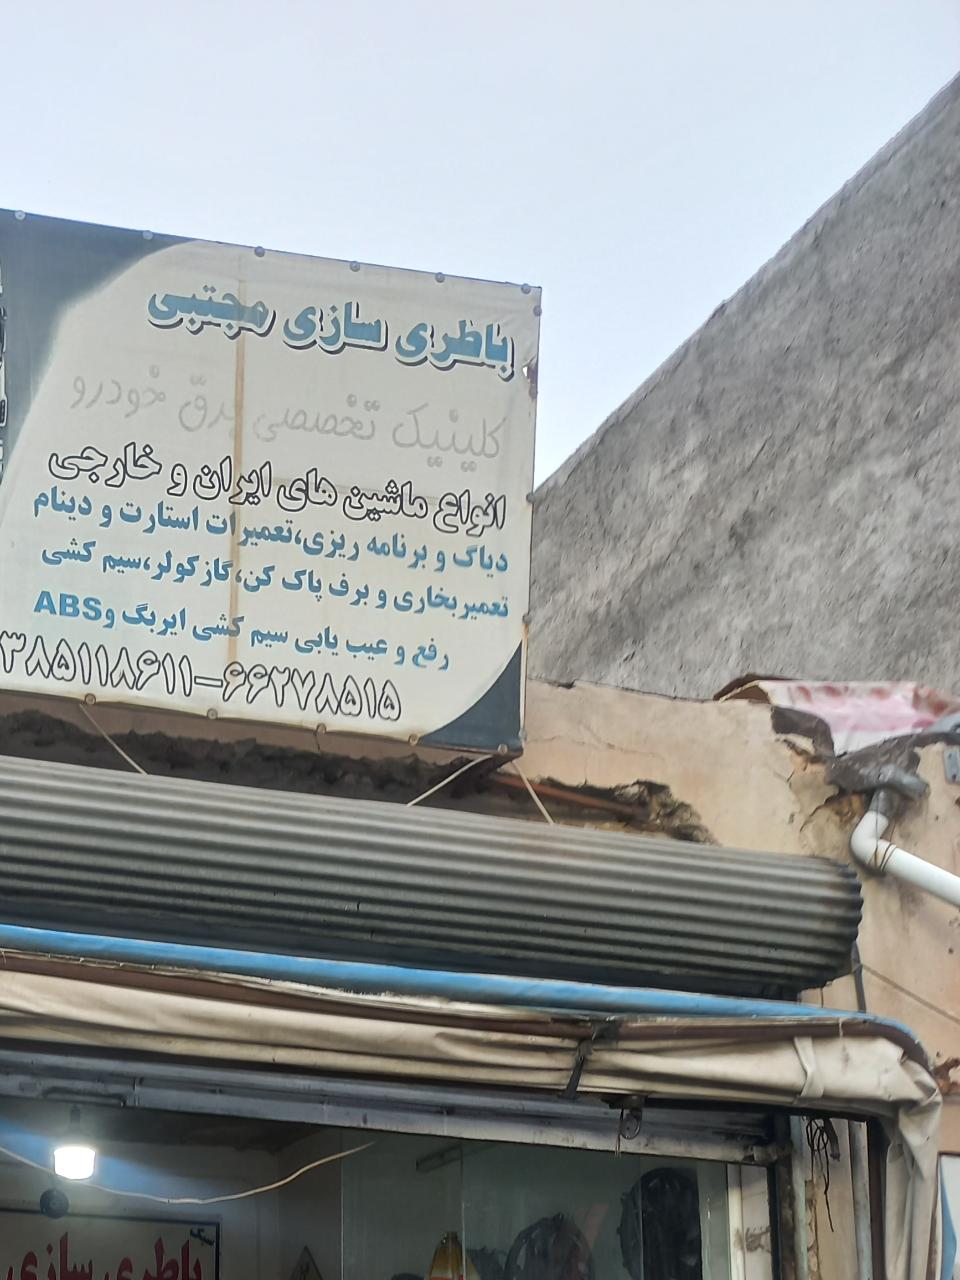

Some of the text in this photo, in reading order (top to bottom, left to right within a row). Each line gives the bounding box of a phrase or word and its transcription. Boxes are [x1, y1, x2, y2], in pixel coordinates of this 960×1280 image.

[147, 284, 514, 381] باطری سازی مجتبی
[70, 365, 167, 418] خودرو
[253, 394, 381, 443] تخصصی
[392, 403, 506, 472] کلینیک
[33, 485, 93, 521] دینام
[48, 442, 506, 537] انواع ماشین های ایران و خارجی
[99, 504, 113, 528] و
[118, 500, 200, 534] استارت
[41, 537, 97, 566] کشی
[365, 533, 429, 569] برنامه
[434, 551, 446, 573] و
[282, 565, 323, 602] پاک
[328, 572, 370, 606] برف
[375, 589, 388, 610] و
[121, 603, 187, 637] ایربگ
[192, 613, 245, 642] کشی
[250, 628, 289, 649] سیم
[293, 626, 339, 657] یابی
[345, 637, 389, 660] عیب
[393, 645, 406, 666] و
[411, 637, 450, 672] رفع
